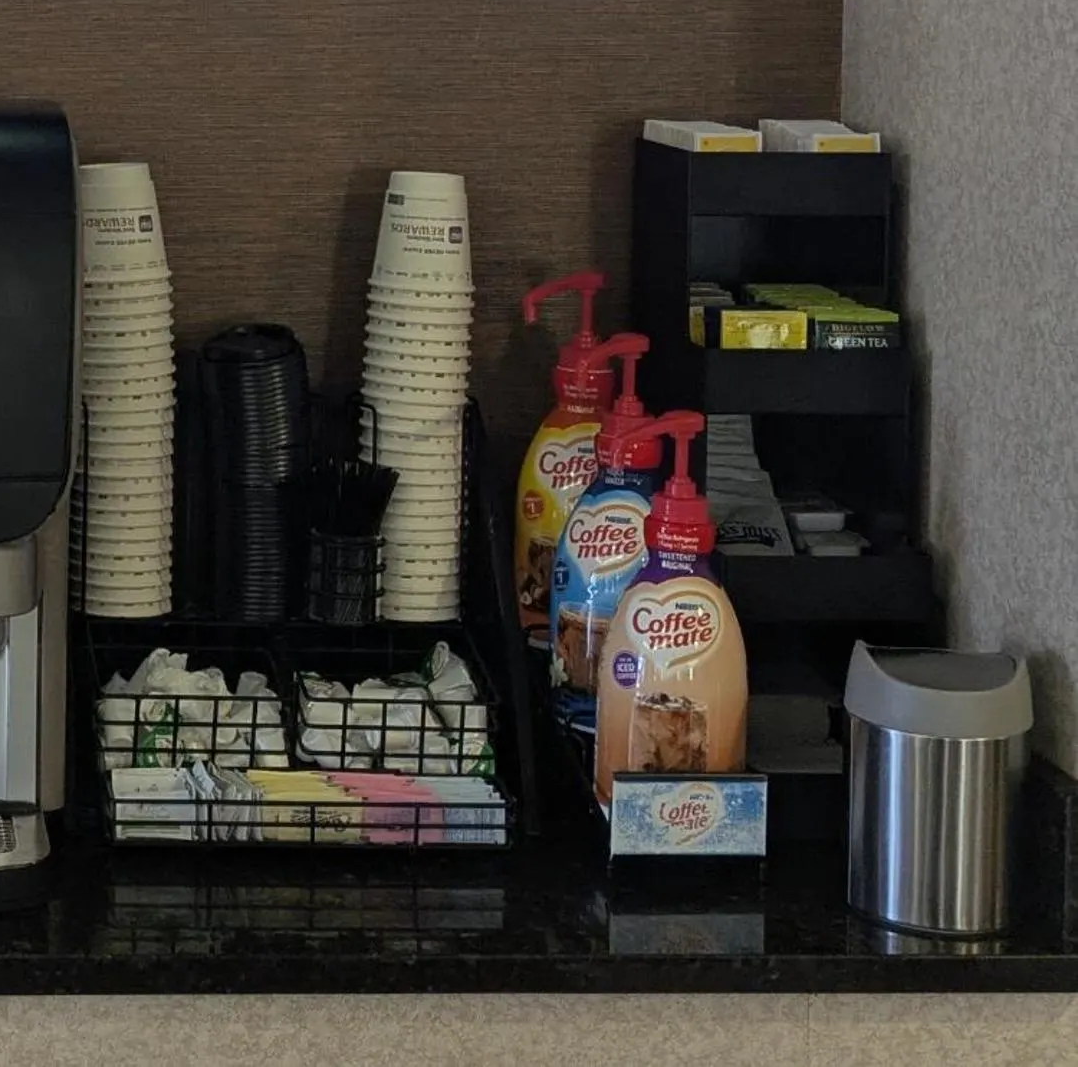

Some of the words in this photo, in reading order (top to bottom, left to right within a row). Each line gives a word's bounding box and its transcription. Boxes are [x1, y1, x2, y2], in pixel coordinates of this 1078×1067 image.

[869, 337, 889, 348] TEA
[539, 450, 596, 475] Coffe
[569, 518, 638, 544] Coffee
[577, 539, 638, 560] mate
[632, 606, 711, 635] Coffee
[649, 626, 715, 650] mate
